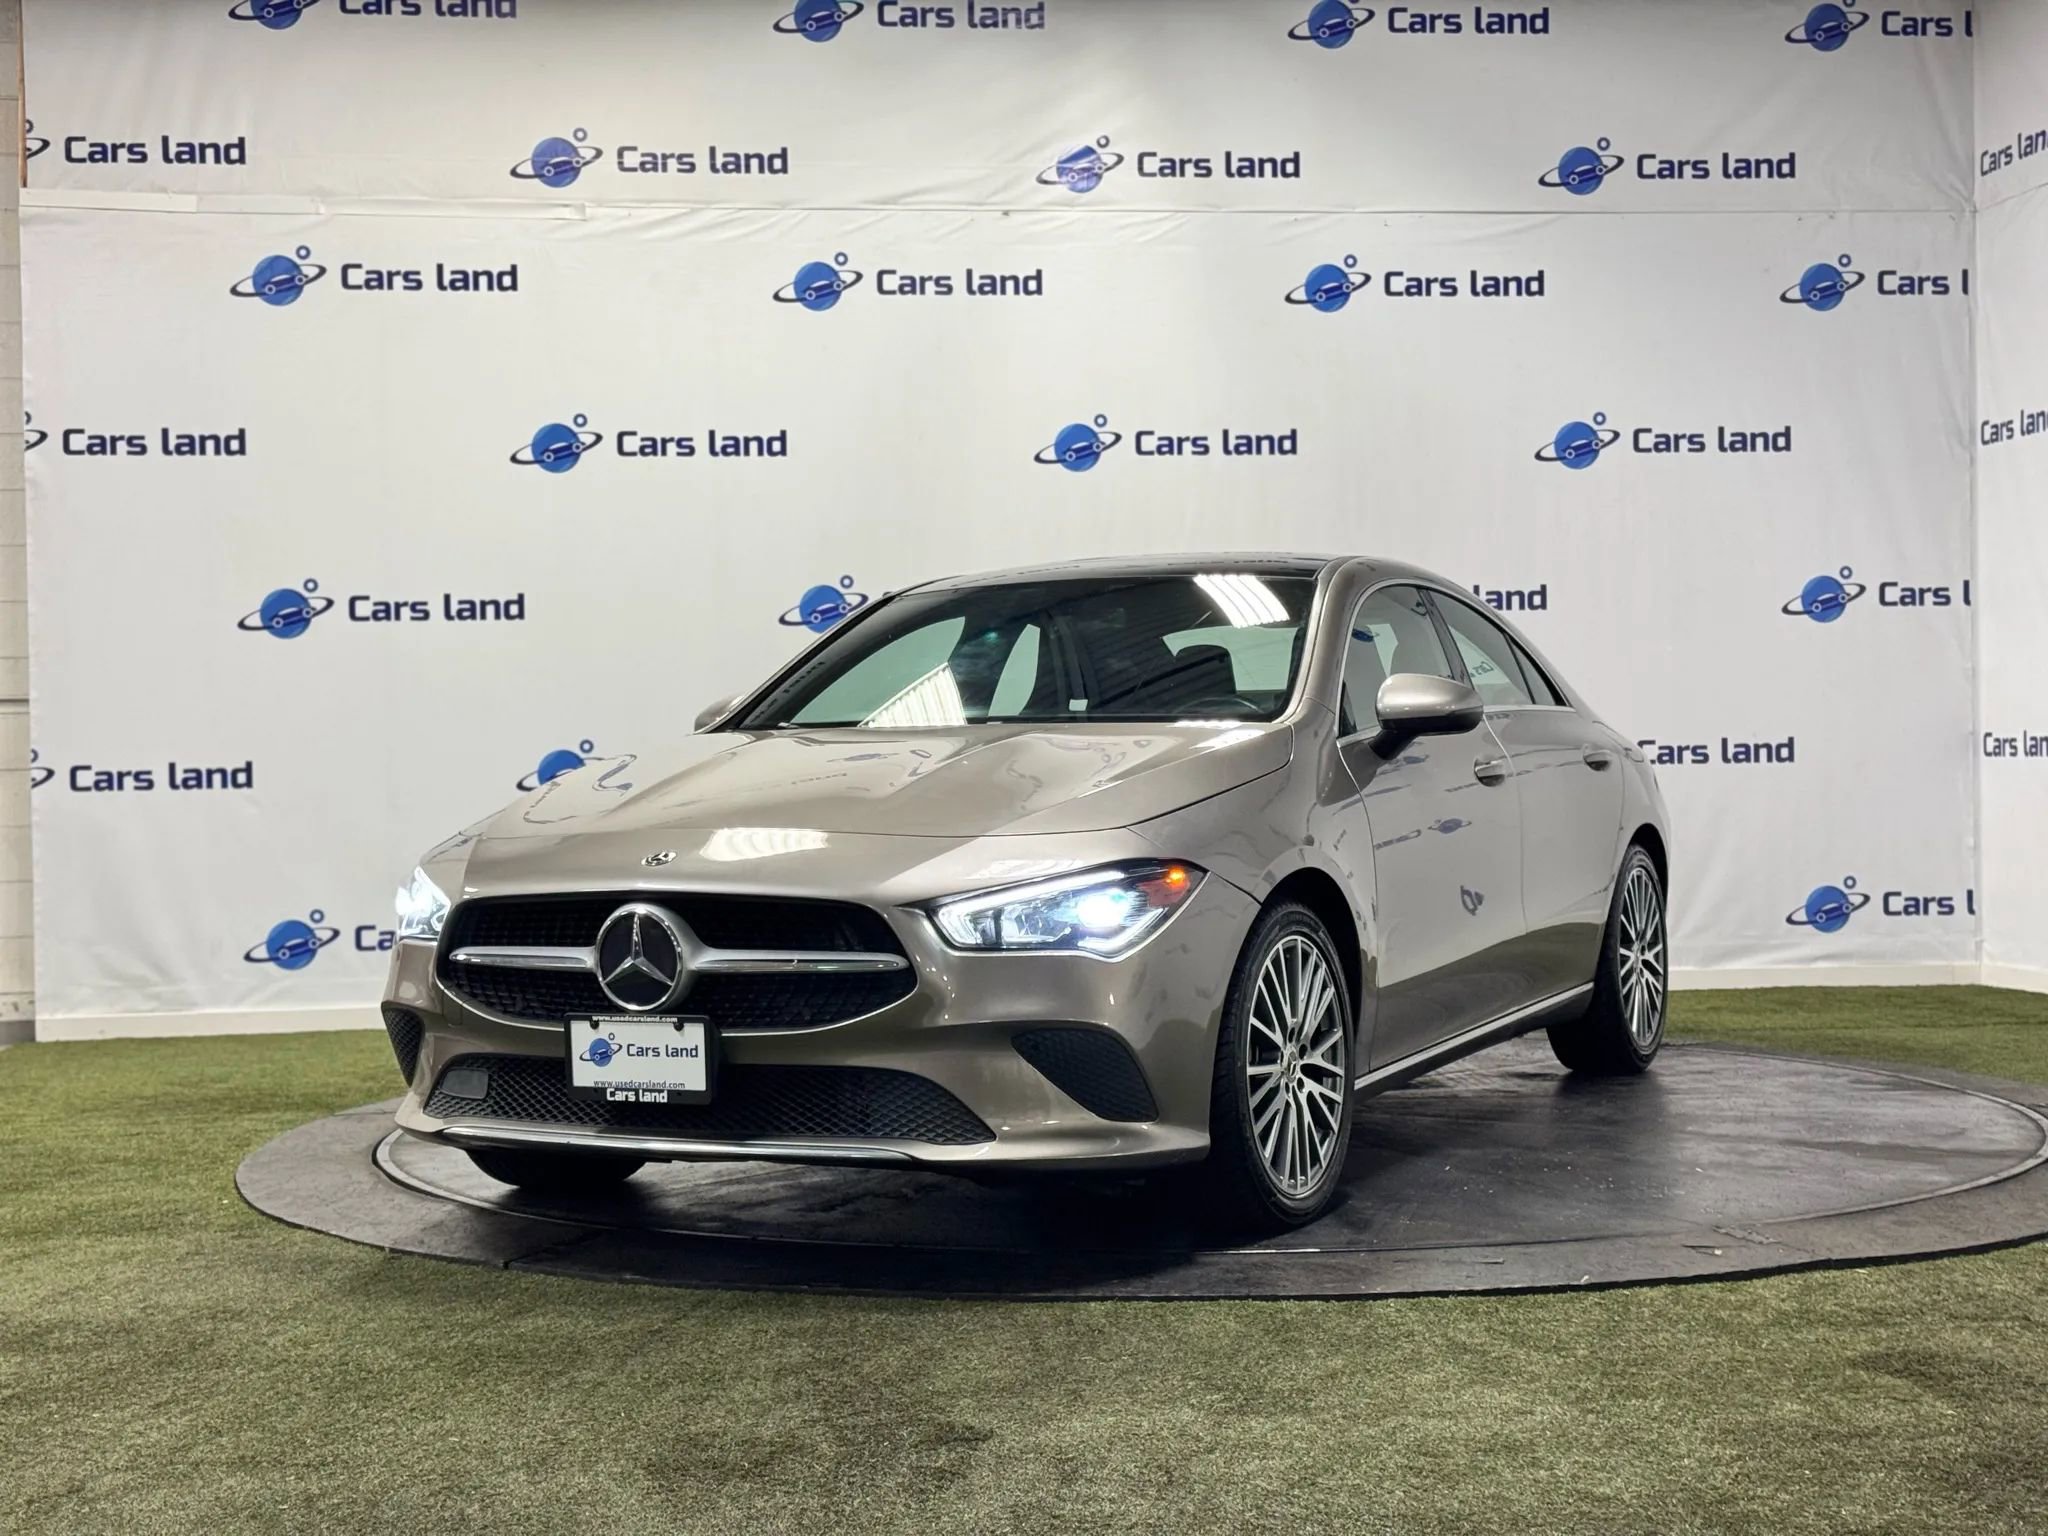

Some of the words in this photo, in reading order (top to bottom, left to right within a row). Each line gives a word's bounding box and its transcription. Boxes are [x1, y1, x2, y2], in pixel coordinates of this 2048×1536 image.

[340, 0, 422, 16] Cars
[877, 0, 955, 28] Cars
[968, 0, 1045, 29] land
[1388, 7, 1462, 33] Cars
[1475, 7, 1549, 34] land
[1881, 11, 1953, 36] Cars
[65, 137, 147, 163] Cars
[162, 136, 245, 164] land
[617, 146, 696, 173] Cars
[710, 146, 788, 174] land
[1980, 145, 2013, 177] Cars
[2017, 129, 2048, 160] lan
[1138, 152, 1212, 177] Cars
[1225, 151, 1300, 178] land
[1637, 154, 1709, 179] Cars
[1723, 152, 1795, 179] land
[341, 264, 422, 290] Cars
[437, 264, 518, 291] land
[877, 270, 953, 295] Cars
[967, 269, 1042, 295] land
[1385, 272, 1458, 296] Cars
[1471, 270, 1544, 296] land
[1878, 270, 1949, 295] Cars
[1633, 428, 1705, 453] Cars
[1718, 426, 1791, 452] land
[1981, 419, 2014, 445] Cars
[2020, 409, 2048, 436] lan
[63, 429, 147, 455] Cars
[162, 428, 246, 456] land
[617, 431, 695, 456] Cars
[709, 430, 786, 456] land
[1136, 431, 1209, 455] Cars
[1223, 429, 1297, 455] land
[349, 595, 430, 621] Cars
[444, 593, 524, 620] land
[1879, 582, 1951, 606] Cars
[1721, 737, 1795, 763] land
[1984, 732, 2018, 757] Cars
[2023, 730, 2048, 757] lan
[70, 765, 154, 791] Cars
[169, 761, 252, 790] land
[1882, 892, 1954, 917] Cars
[355, 925, 396, 951] Ca
[592, 1015, 678, 1023] www.usedcarsland.com
[626, 1043, 661, 1058] Cars
[665, 1044, 699, 1059] land
[594, 1080, 686, 1089] www.usedcarsland.com
[606, 1087, 636, 1102] Cars
[639, 1089, 668, 1103] land
